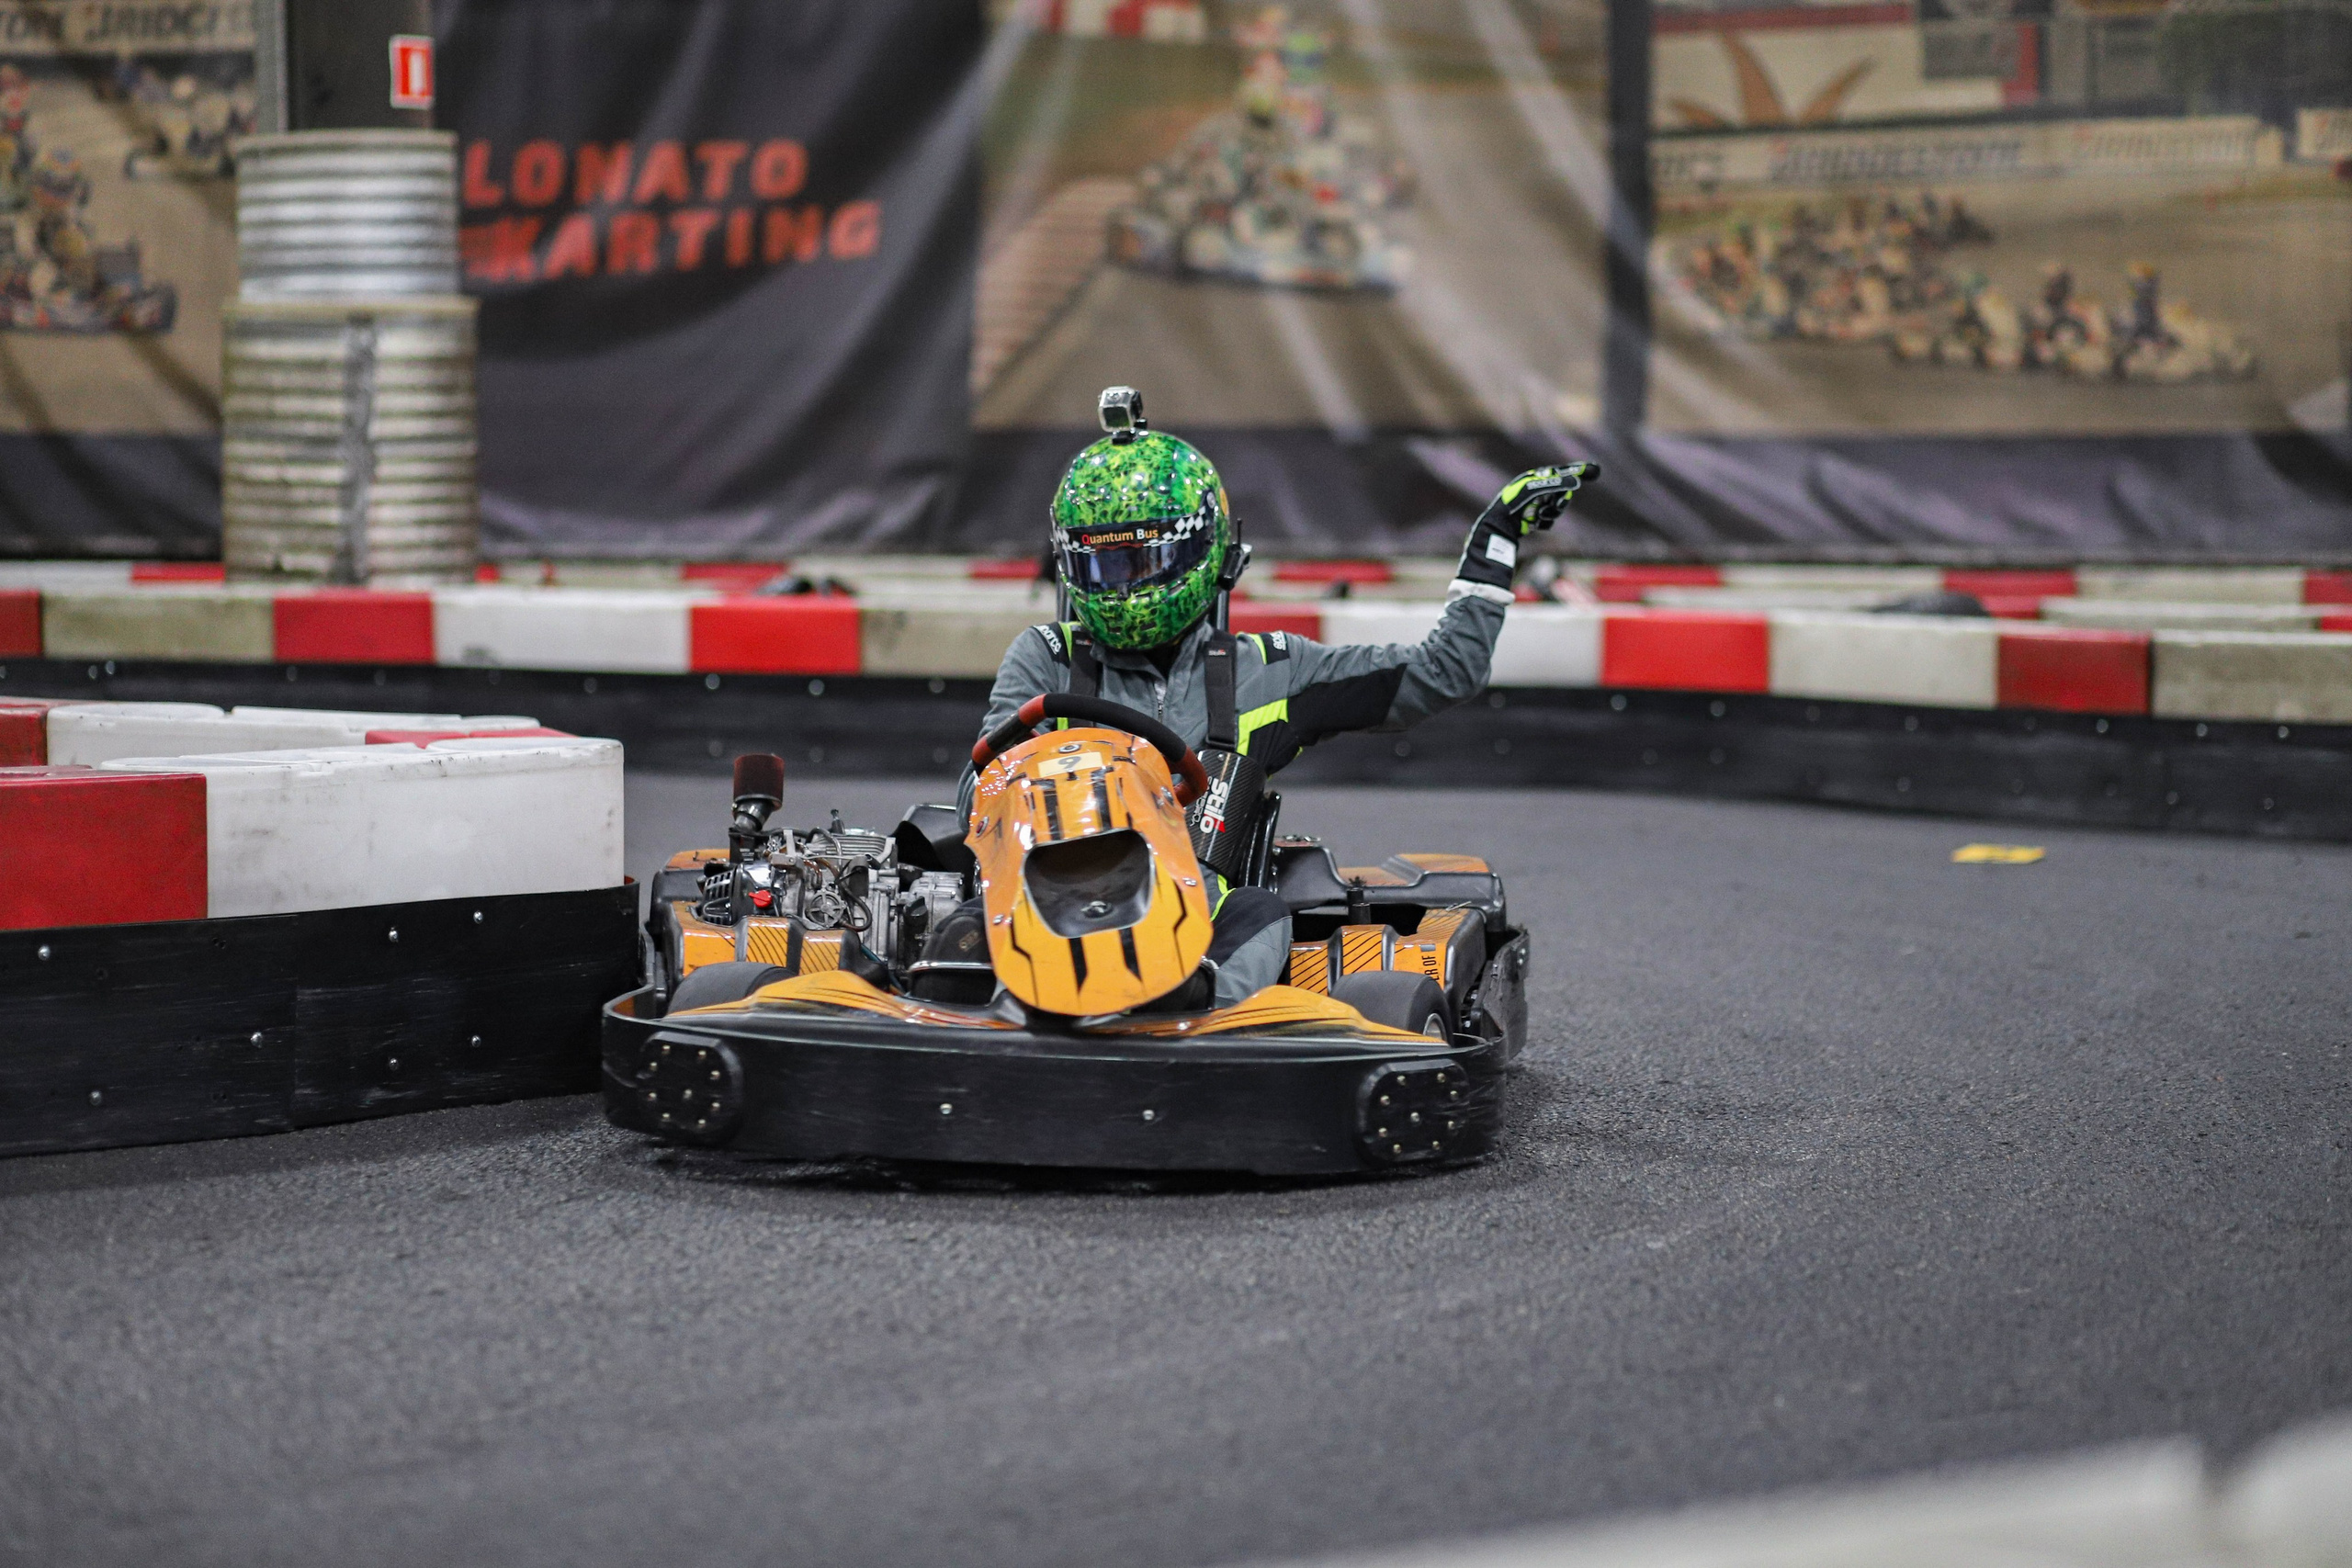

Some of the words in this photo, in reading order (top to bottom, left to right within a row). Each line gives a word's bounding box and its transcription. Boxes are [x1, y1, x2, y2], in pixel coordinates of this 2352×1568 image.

[462, 139, 808, 208] LONATO
[469, 200, 881, 282] KARTING
[1081, 533, 1134, 546] Quantum
[1136, 528, 1159, 540] Bus
[1200, 778, 1228, 834] Stilo
[1421, 955, 1437, 966] OF
